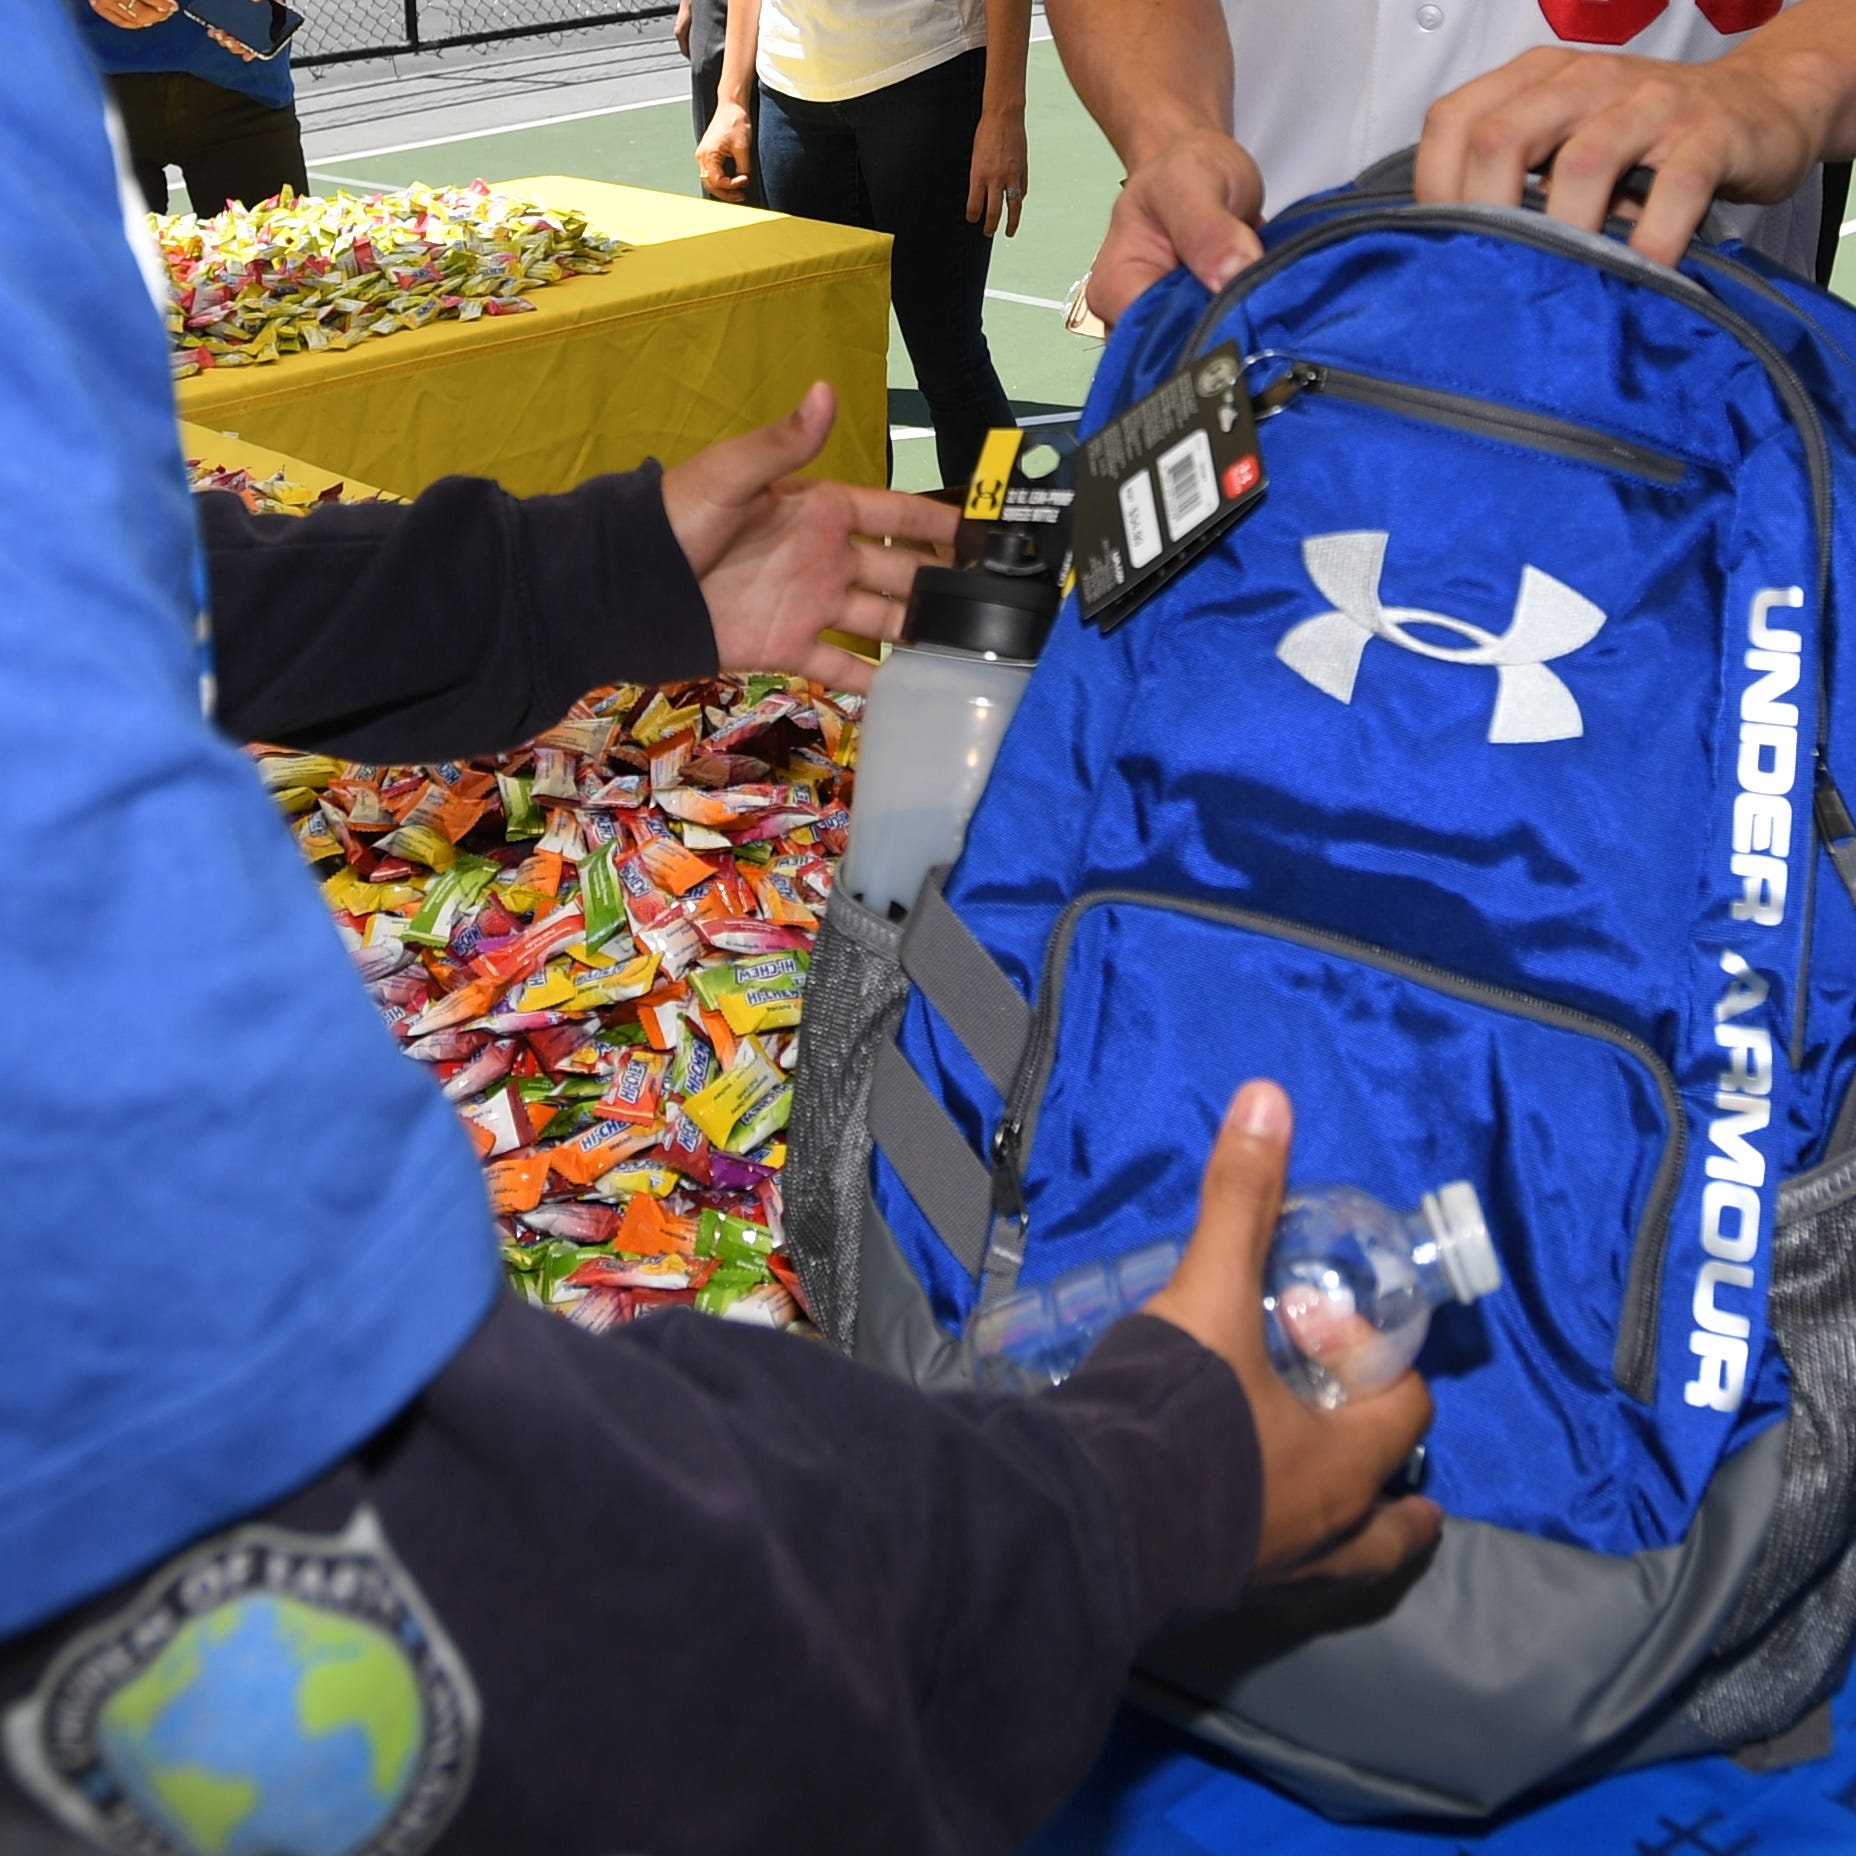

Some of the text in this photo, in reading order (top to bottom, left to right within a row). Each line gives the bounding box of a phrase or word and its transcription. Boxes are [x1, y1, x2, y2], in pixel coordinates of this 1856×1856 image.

[1730, 585, 1804, 928] UNDER
[737, 959, 796, 982] HI-CHEW
[580, 1118, 631, 1151] HI-CHE
[1684, 949, 1776, 1414] ARMOUR
